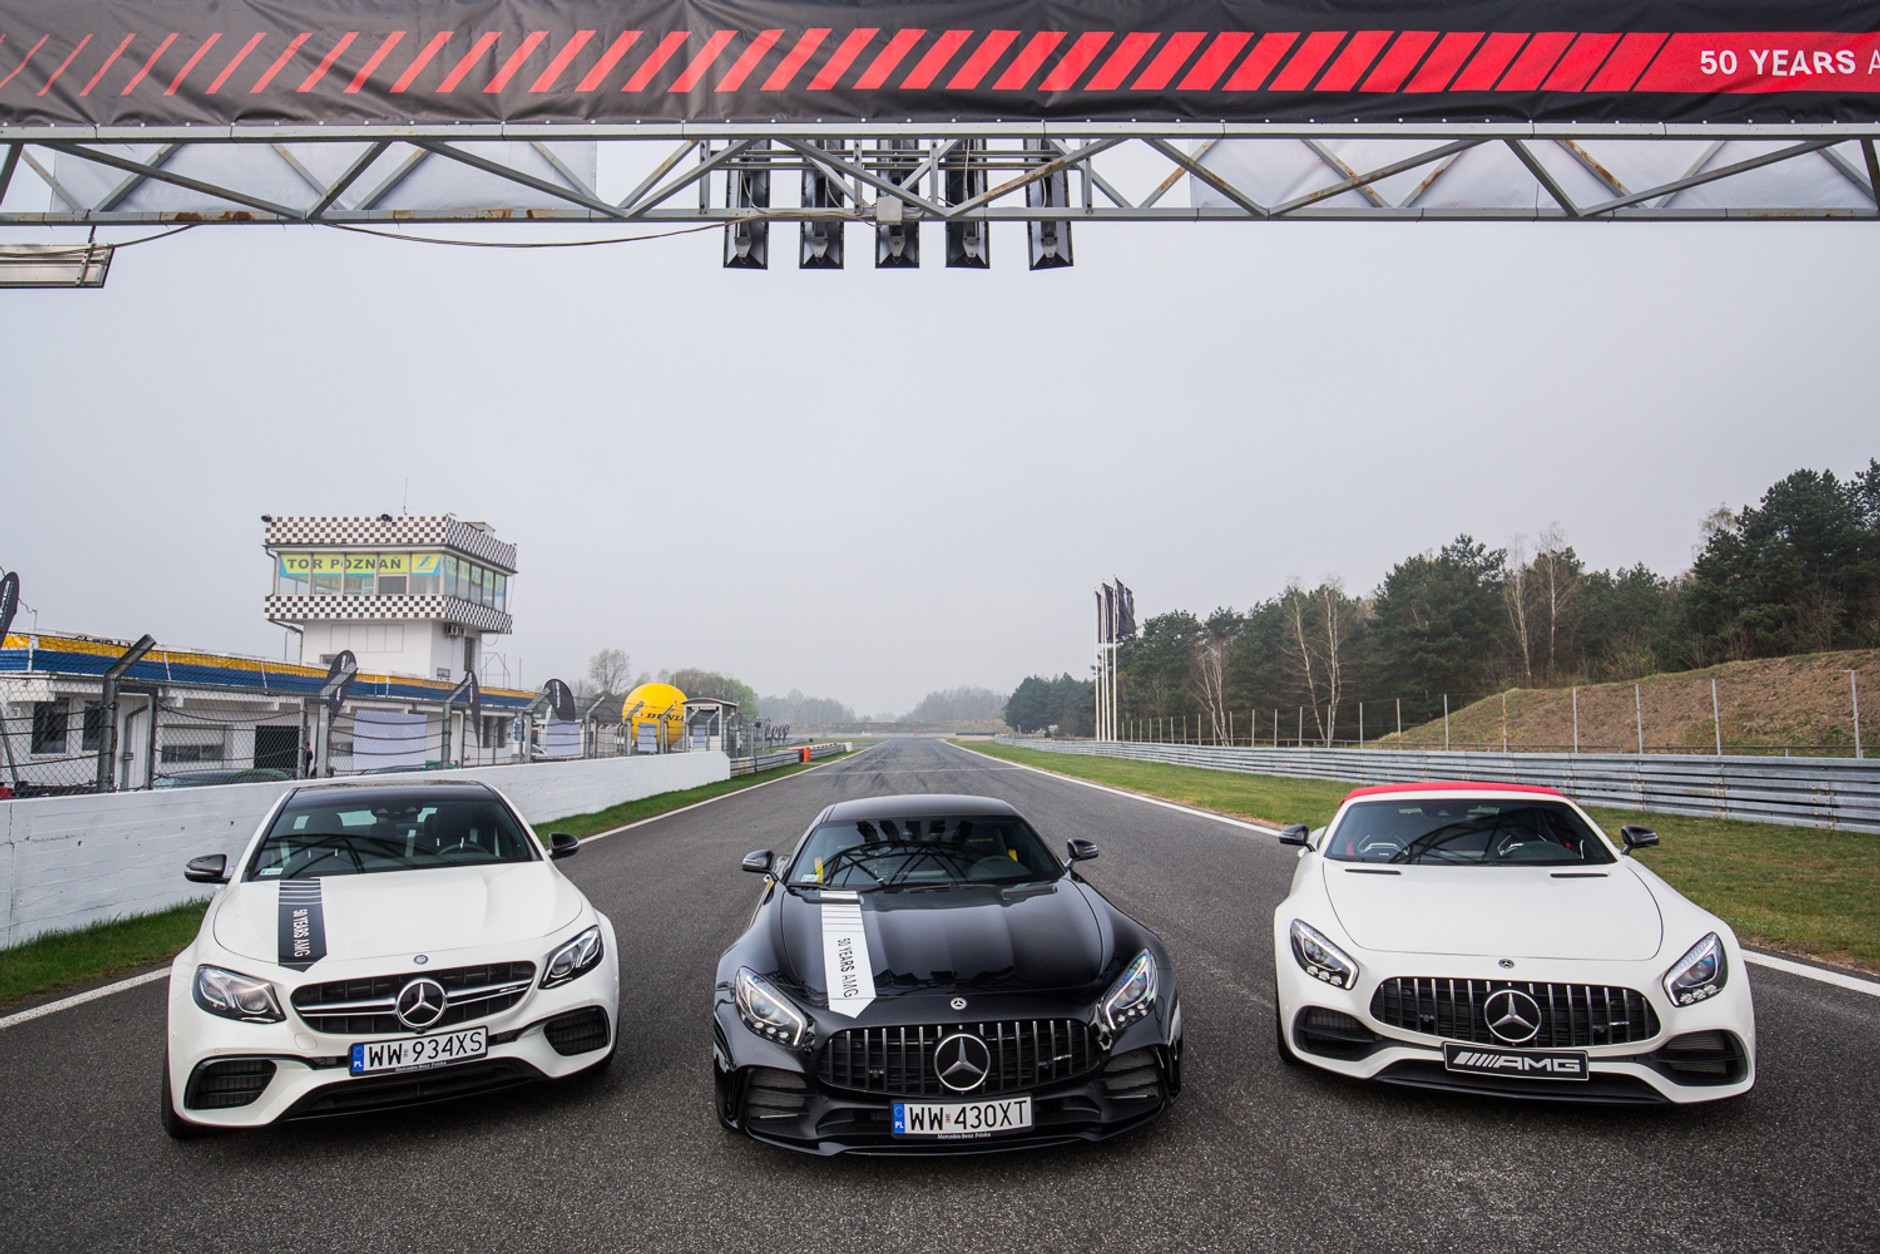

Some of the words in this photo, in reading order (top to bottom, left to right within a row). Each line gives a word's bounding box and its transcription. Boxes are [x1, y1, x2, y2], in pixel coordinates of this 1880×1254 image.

[1700, 50, 1738, 75] 50
[1749, 49, 1856, 77] YEARS
[287, 559, 322, 570] TOR
[330, 556, 401, 570] POZNAŃ
[293, 916, 310, 938] YEARS
[294, 939, 311, 957] AMG
[837, 937, 851, 947] 50
[838, 946, 855, 973] YEARS
[841, 974, 859, 998] AMG
[368, 1043, 402, 1067] WW
[412, 1031, 482, 1063] 934XS
[894, 1121, 904, 1129] PL
[909, 1106, 943, 1131] WW
[954, 1100, 1028, 1130] 430XT
